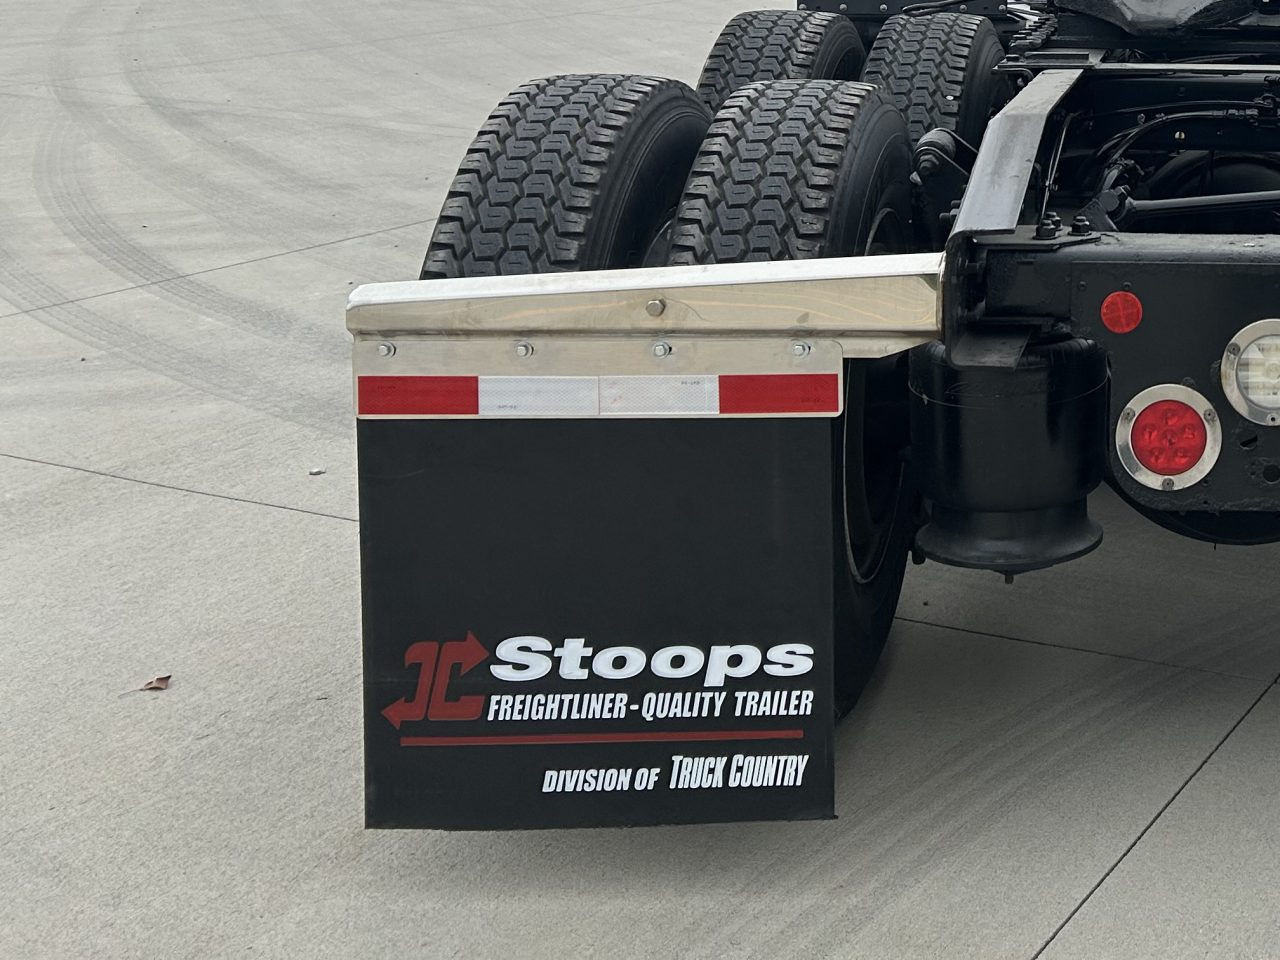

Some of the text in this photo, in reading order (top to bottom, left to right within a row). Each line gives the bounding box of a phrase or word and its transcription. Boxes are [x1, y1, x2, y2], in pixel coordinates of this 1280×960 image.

[489, 635, 815, 688] Stoops
[734, 690, 814, 717] TRAILER
[542, 754, 809, 793] DIVISION OF TRUCK COUNTRY
